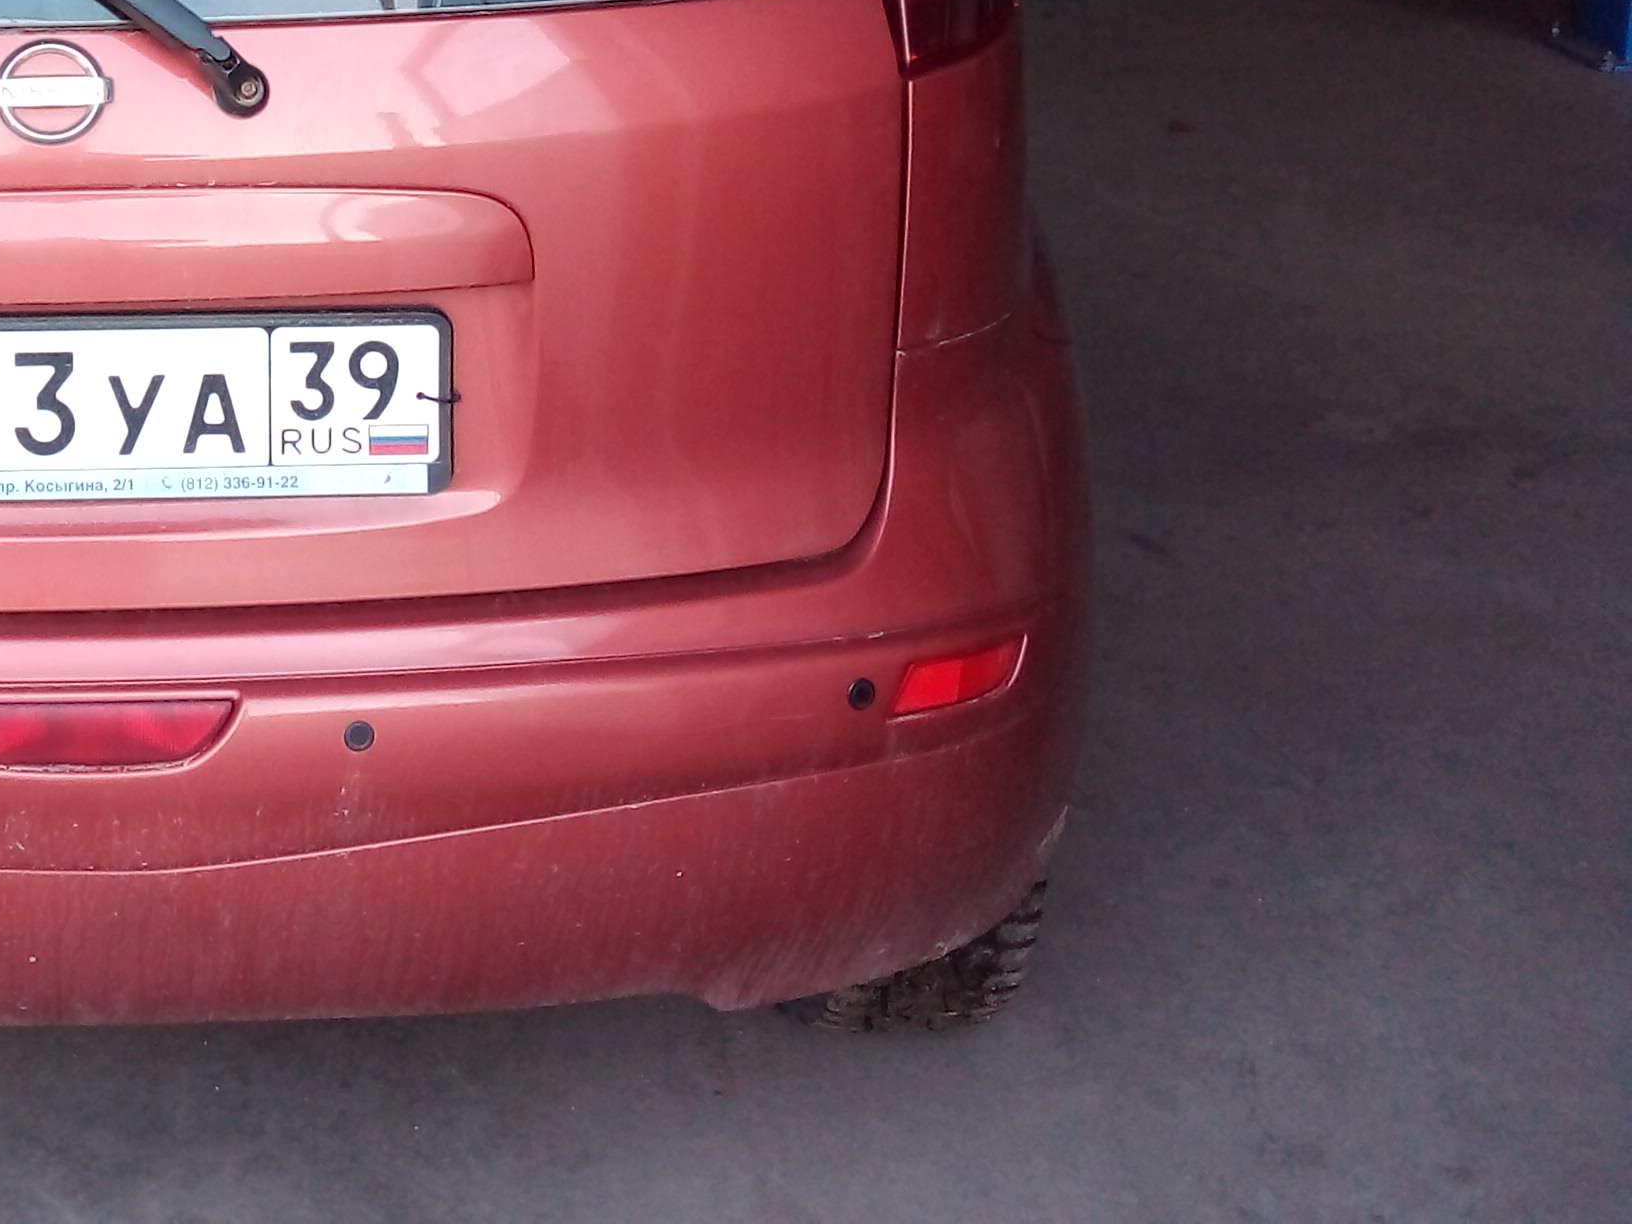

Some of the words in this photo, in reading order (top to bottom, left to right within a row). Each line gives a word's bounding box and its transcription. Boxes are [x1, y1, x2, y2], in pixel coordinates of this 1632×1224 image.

[288, 339, 400, 421] 39
[280, 426, 363, 456] RUS
[23, 478, 109, 494] Косыгина,
[112, 477, 135, 492] 2/1
[180, 477, 219, 493] (812)
[222, 475, 300, 490] 336-91-22
